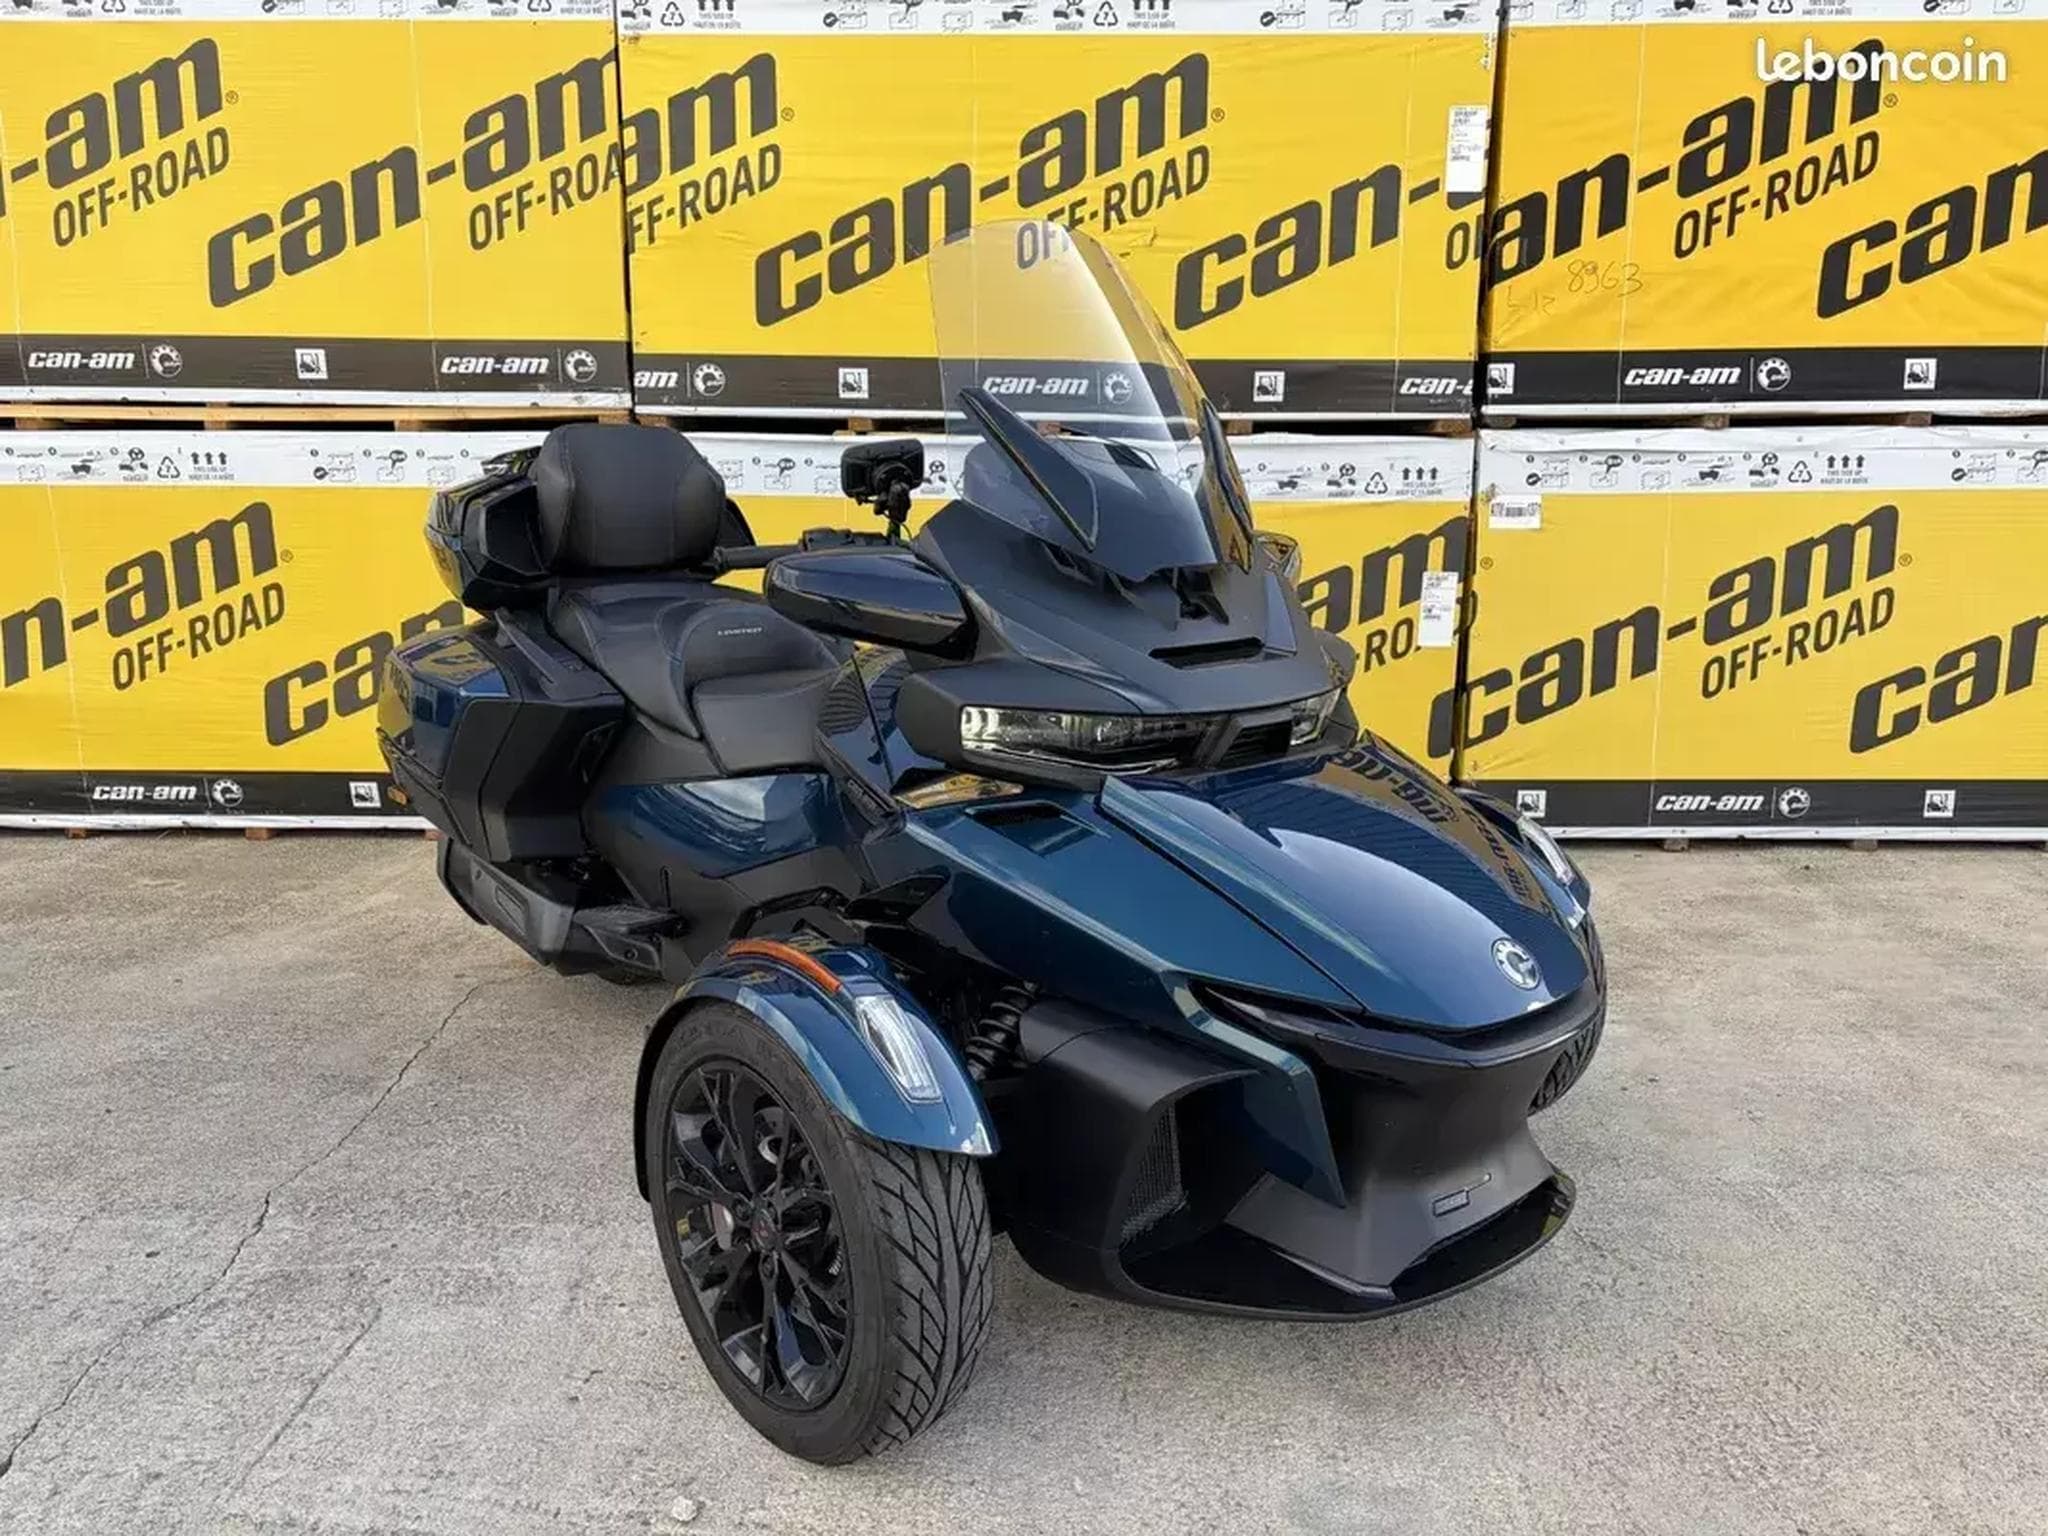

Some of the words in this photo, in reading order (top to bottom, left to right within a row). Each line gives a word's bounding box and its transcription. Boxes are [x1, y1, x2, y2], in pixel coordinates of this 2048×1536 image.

[53, 127, 230, 247] OFF-ROAD
[755, 53, 1209, 327] can-am
[1017, 146, 1210, 270] OFF-ROAD
[1674, 130, 1880, 258] OFF-ROAD
[28, 352, 135, 370] can-am
[440, 356, 550, 374] can-am
[982, 376, 1089, 395] can-am
[1624, 367, 1741, 385] can-am
[2, 502, 279, 688] n-am
[112, 581, 285, 690] OFF-ROAD
[1428, 504, 1900, 758] can-am
[1701, 587, 1894, 698] OFF-ROAD
[93, 785, 197, 800] can-am
[1655, 795, 1764, 811] can-am
